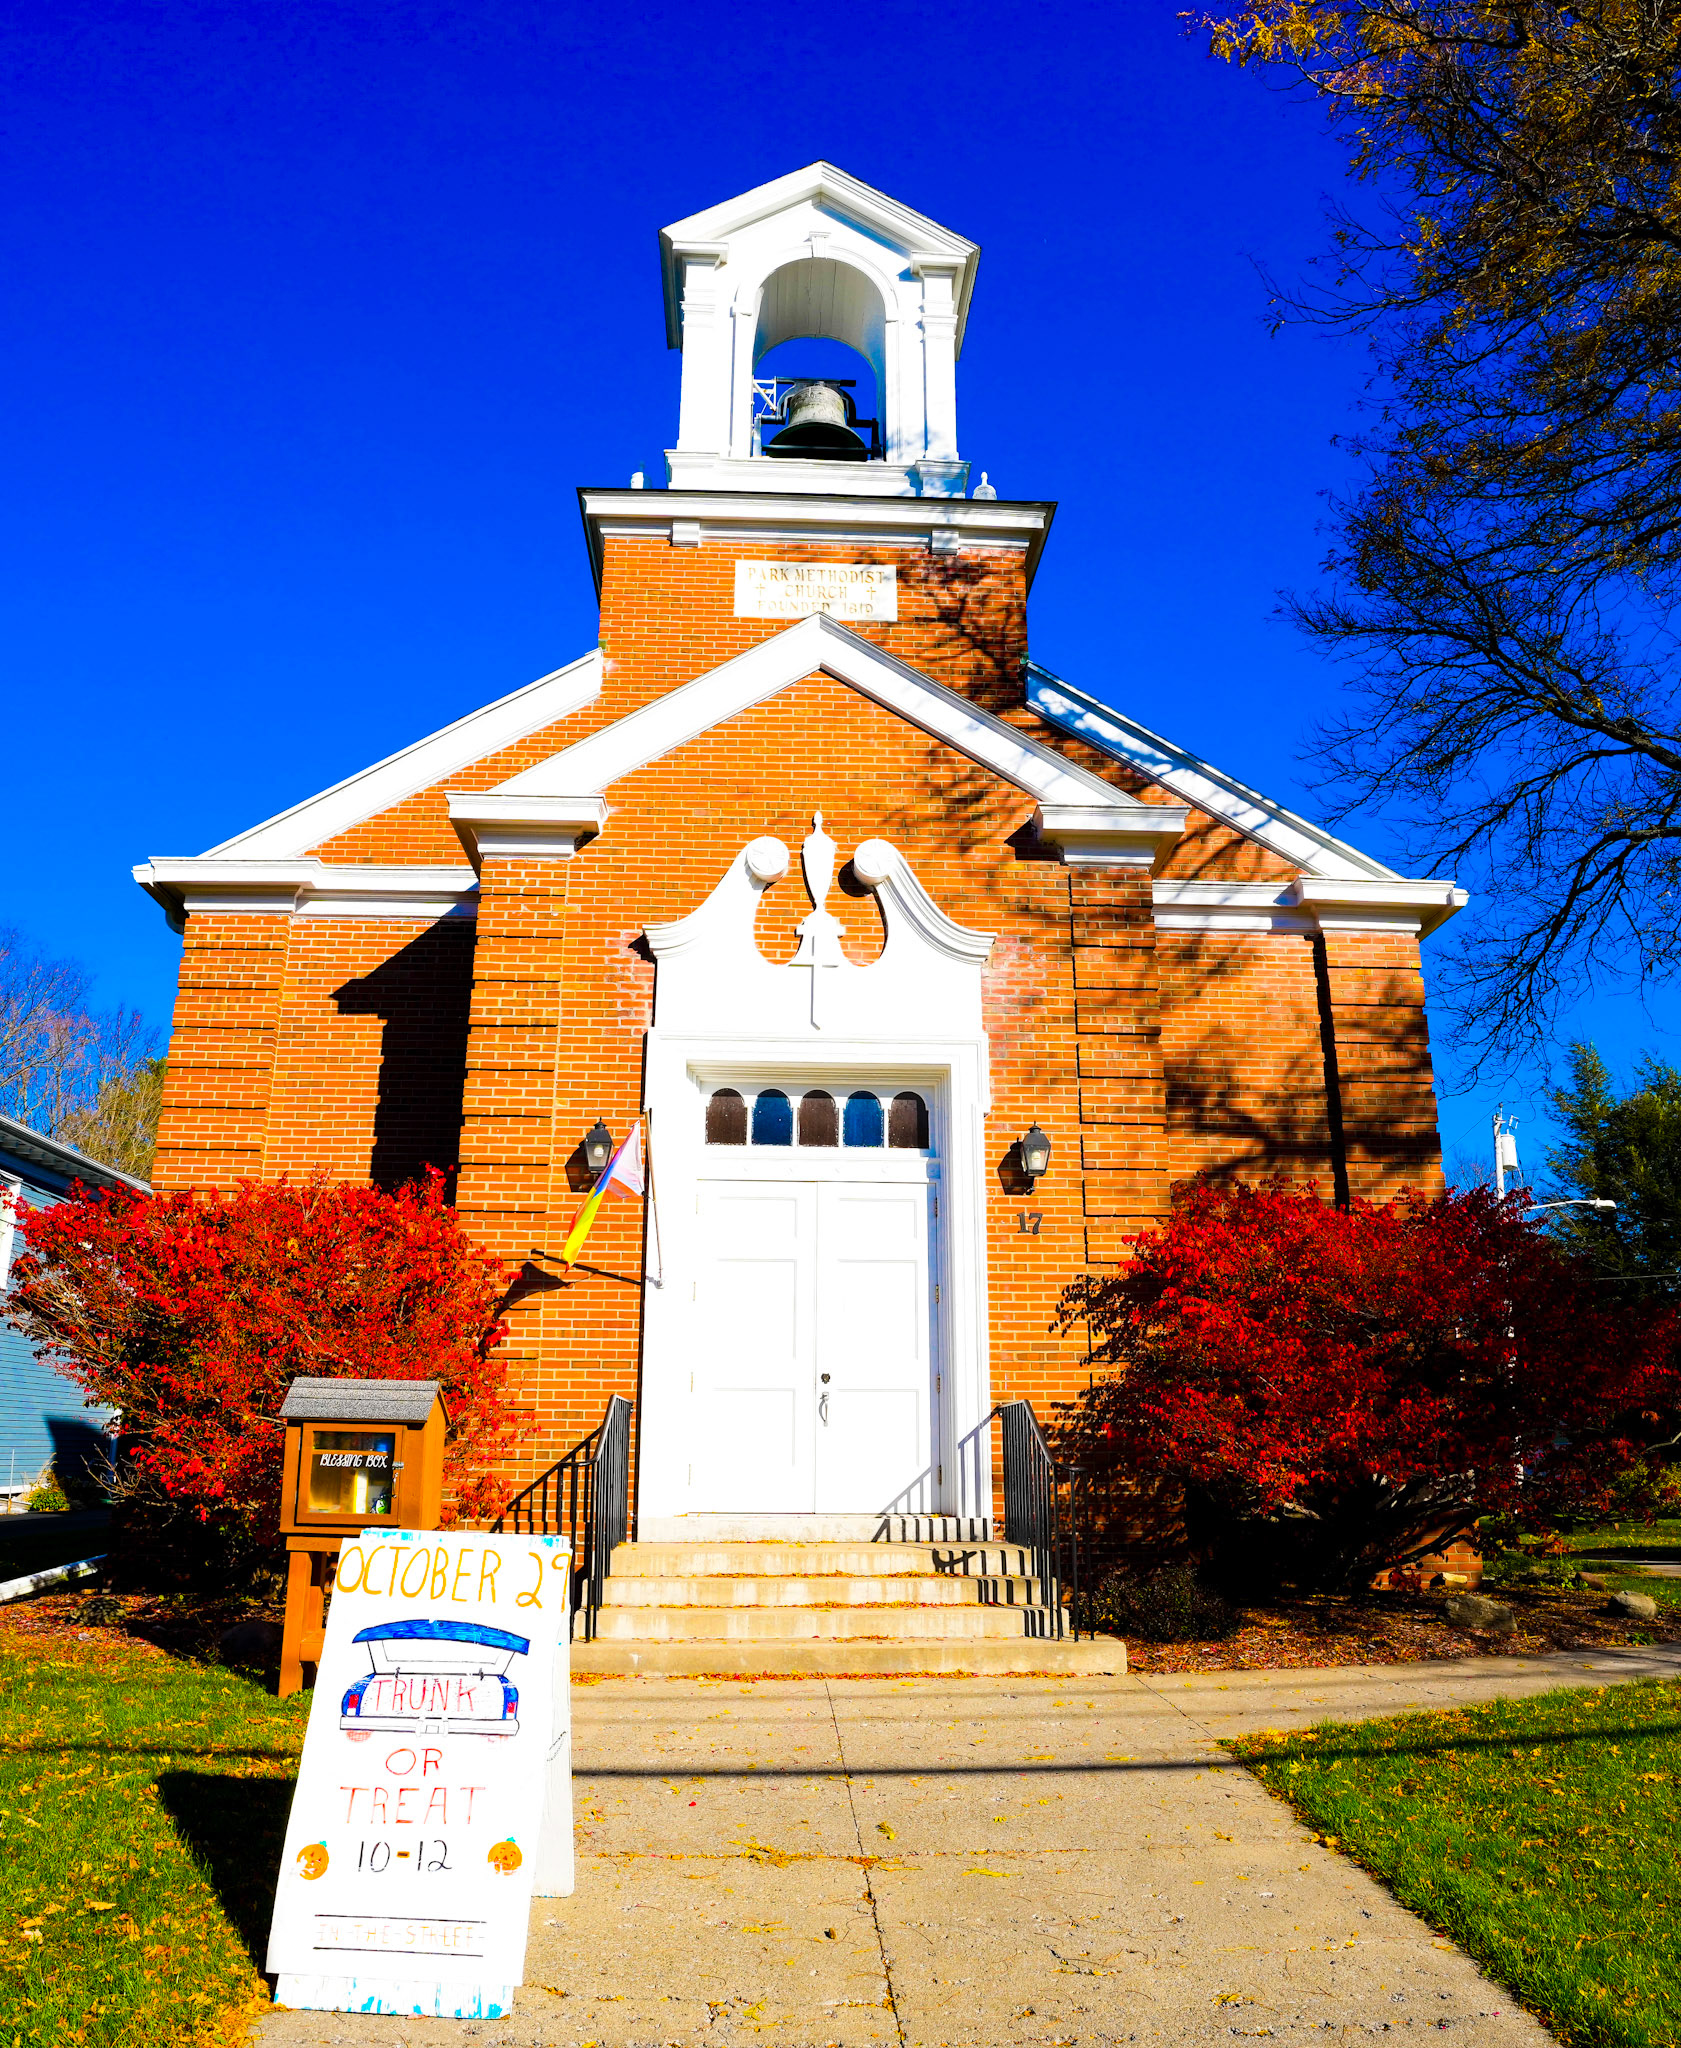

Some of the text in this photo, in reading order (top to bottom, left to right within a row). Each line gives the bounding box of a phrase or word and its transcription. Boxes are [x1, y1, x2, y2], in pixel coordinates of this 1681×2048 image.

[748, 567, 885, 584] PARK METHODIST
[784, 584, 847, 599] CHURCH
[758, 600, 830, 614] FOUNDED
[1016, 1212, 1043, 1235] 17
[320, 1453, 388, 1468] BLESSING BOX
[336, 1545, 572, 1613] OCTOBER 29
[373, 1678, 476, 1712] TRUNK
[385, 1748, 443, 1777] OR
[340, 1786, 486, 1825] TREAT
[358, 1839, 453, 1873] 10-12
[319, 1924, 474, 1948] IN THE STREET
